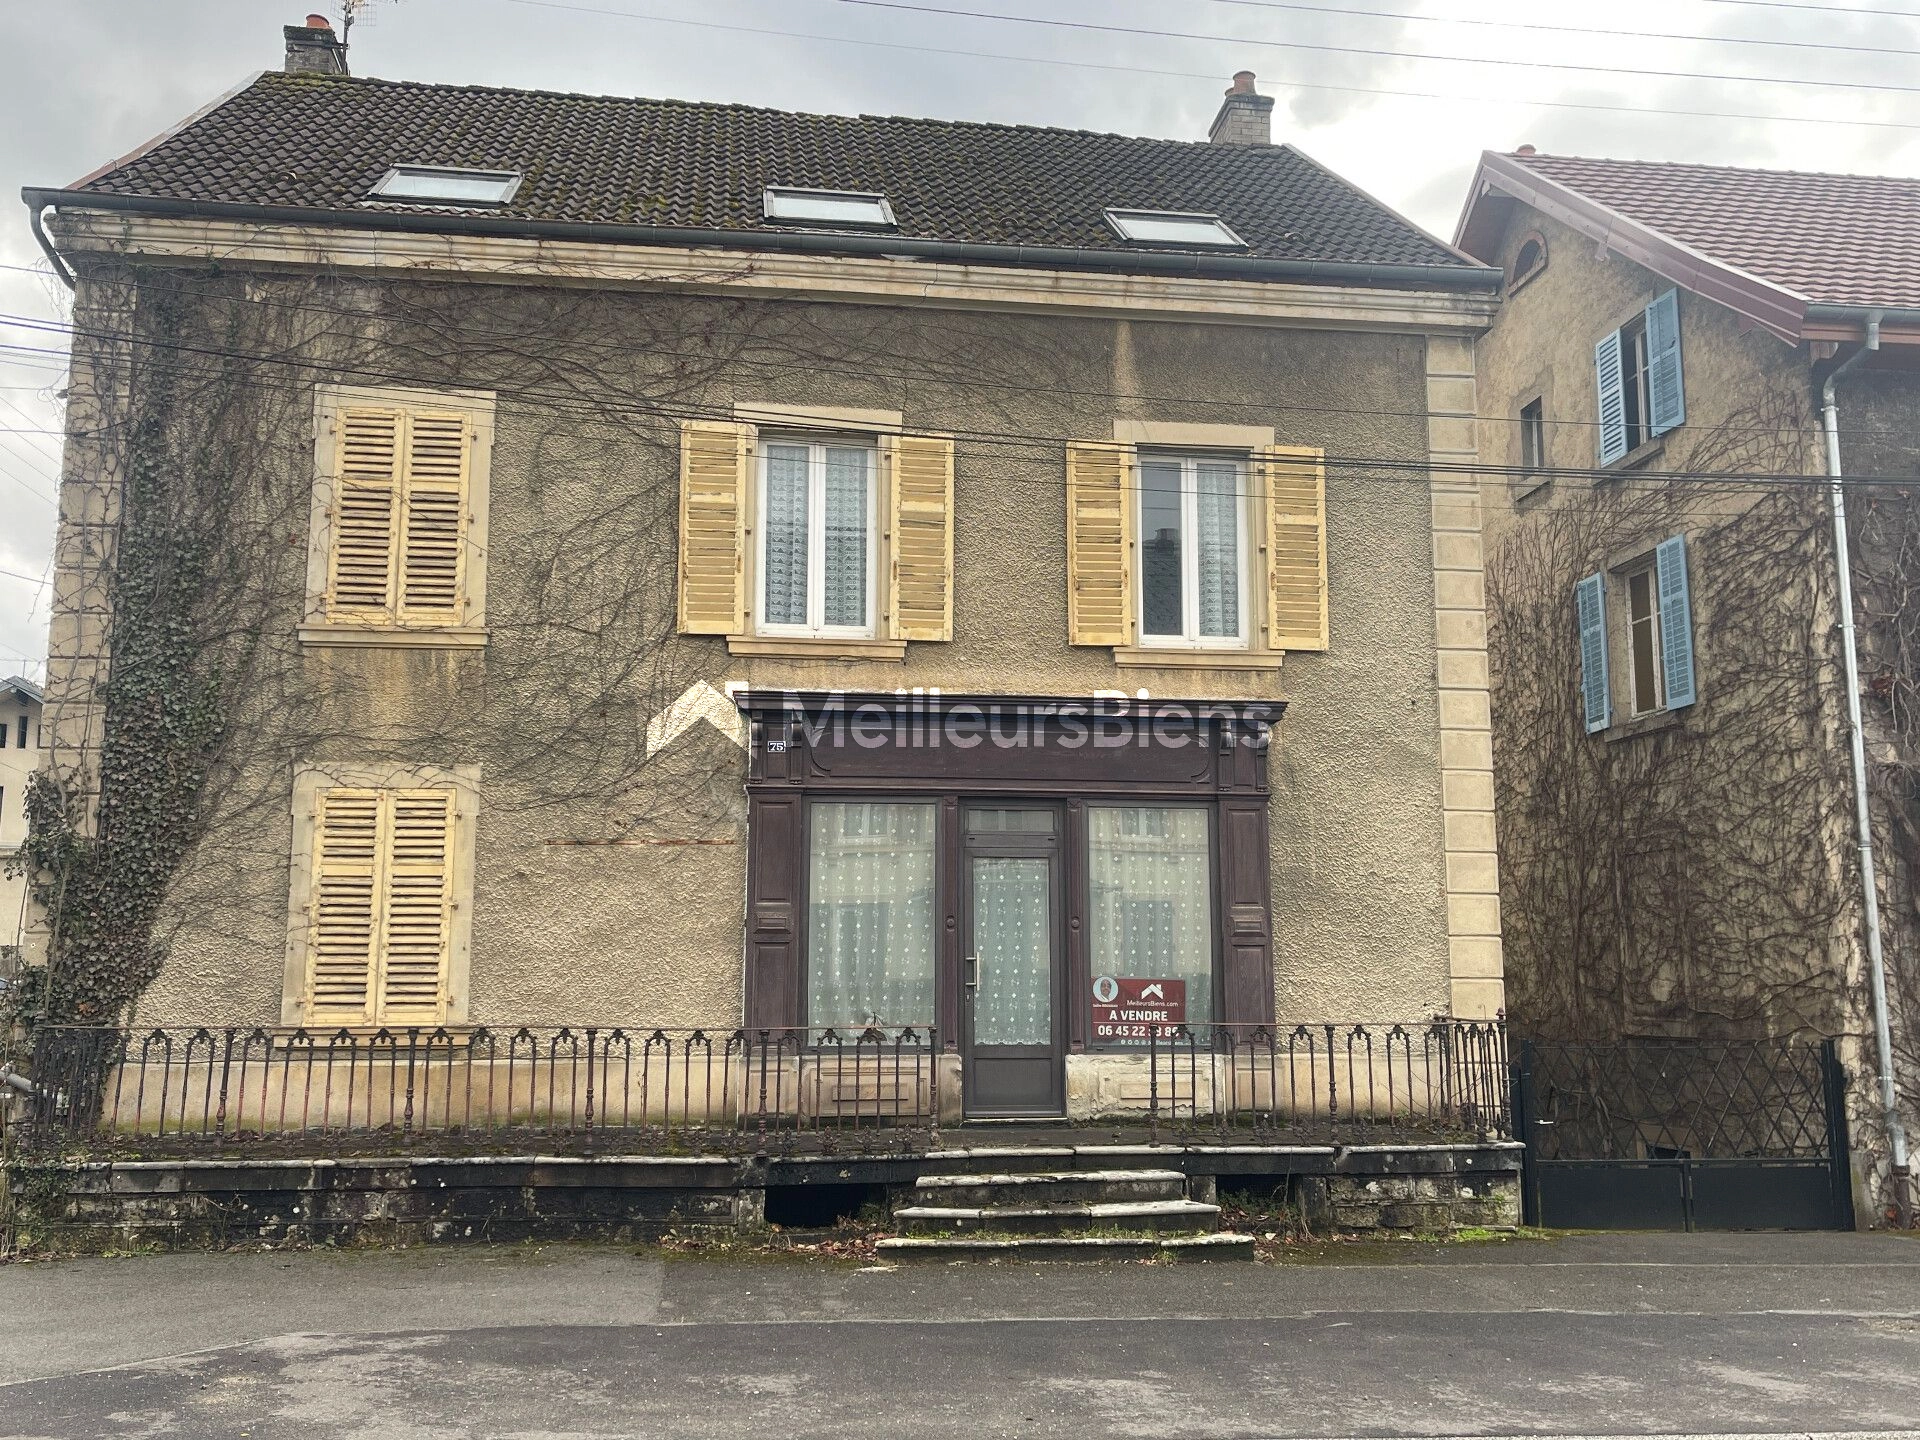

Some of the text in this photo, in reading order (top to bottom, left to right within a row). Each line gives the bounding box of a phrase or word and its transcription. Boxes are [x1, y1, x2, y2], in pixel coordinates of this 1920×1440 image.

[770, 742, 783, 751] 75
[1109, 1010, 1168, 1021] A VENDRE
[1098, 1025, 1113, 1036] 06
[1115, 1025, 1129, 1036] 45
[1131, 1026, 1146, 1037] 22
